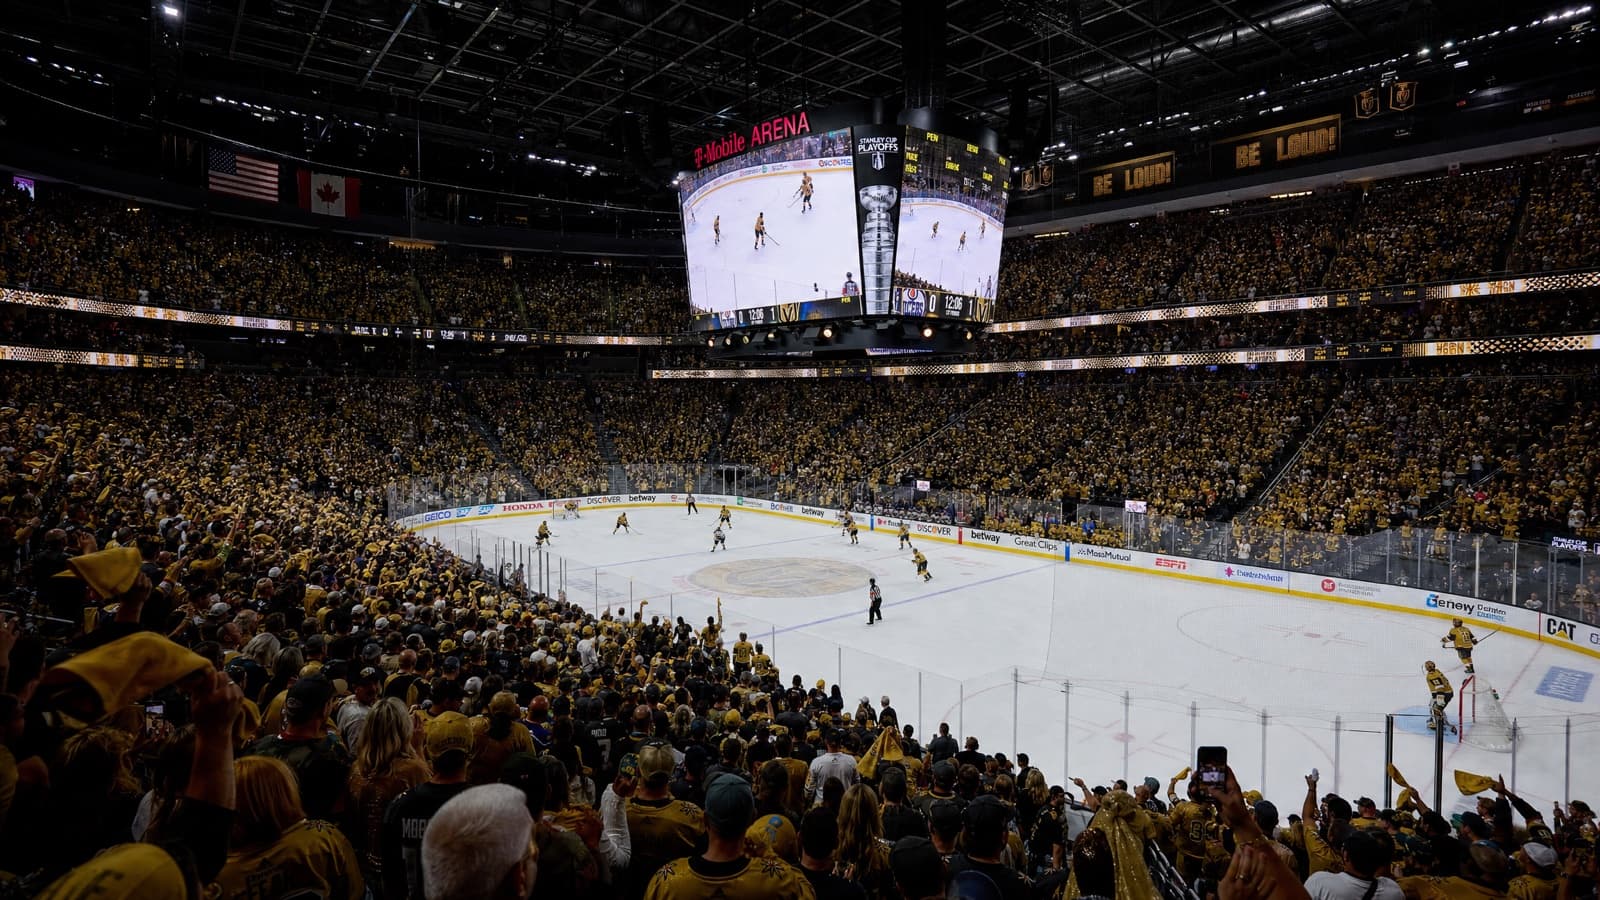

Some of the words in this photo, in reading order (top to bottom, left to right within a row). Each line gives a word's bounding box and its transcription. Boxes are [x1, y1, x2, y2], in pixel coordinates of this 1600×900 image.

[751, 111, 811, 147] ARENA
[858, 143, 898, 152] PLAYOFFS
[859, 137, 885, 145] STANLEY
[1235, 142, 1261, 169] BE
[1276, 126, 1337, 161] LOUD!
[1092, 173, 1113, 197] BE
[1124, 161, 1172, 191] LOUD!
[929, 294, 936, 312] 0
[945, 295, 963, 310] 12:06
[968, 299, 973, 315] 1
[738, 311, 744, 324] 0
[748, 307, 764, 321] 12:06
[770, 307, 775, 320] 1
[587, 496, 621, 504] DISCOVER
[629, 494, 656, 503] betway
[503, 502, 544, 511] HONDA
[801, 506, 825, 518] betway
[425, 510, 451, 522] GEICO
[917, 523, 951, 536] DISCOVER
[971, 530, 1001, 544] betway
[1014, 536, 1037, 547] Great
[1037, 540, 1058, 551] Clips
[1551, 541, 1588, 552] PLAYOFFS
[1086, 548, 1132, 561] MassMutual
[1155, 557, 1187, 570] ESPN
[1547, 618, 1576, 640] CAT
